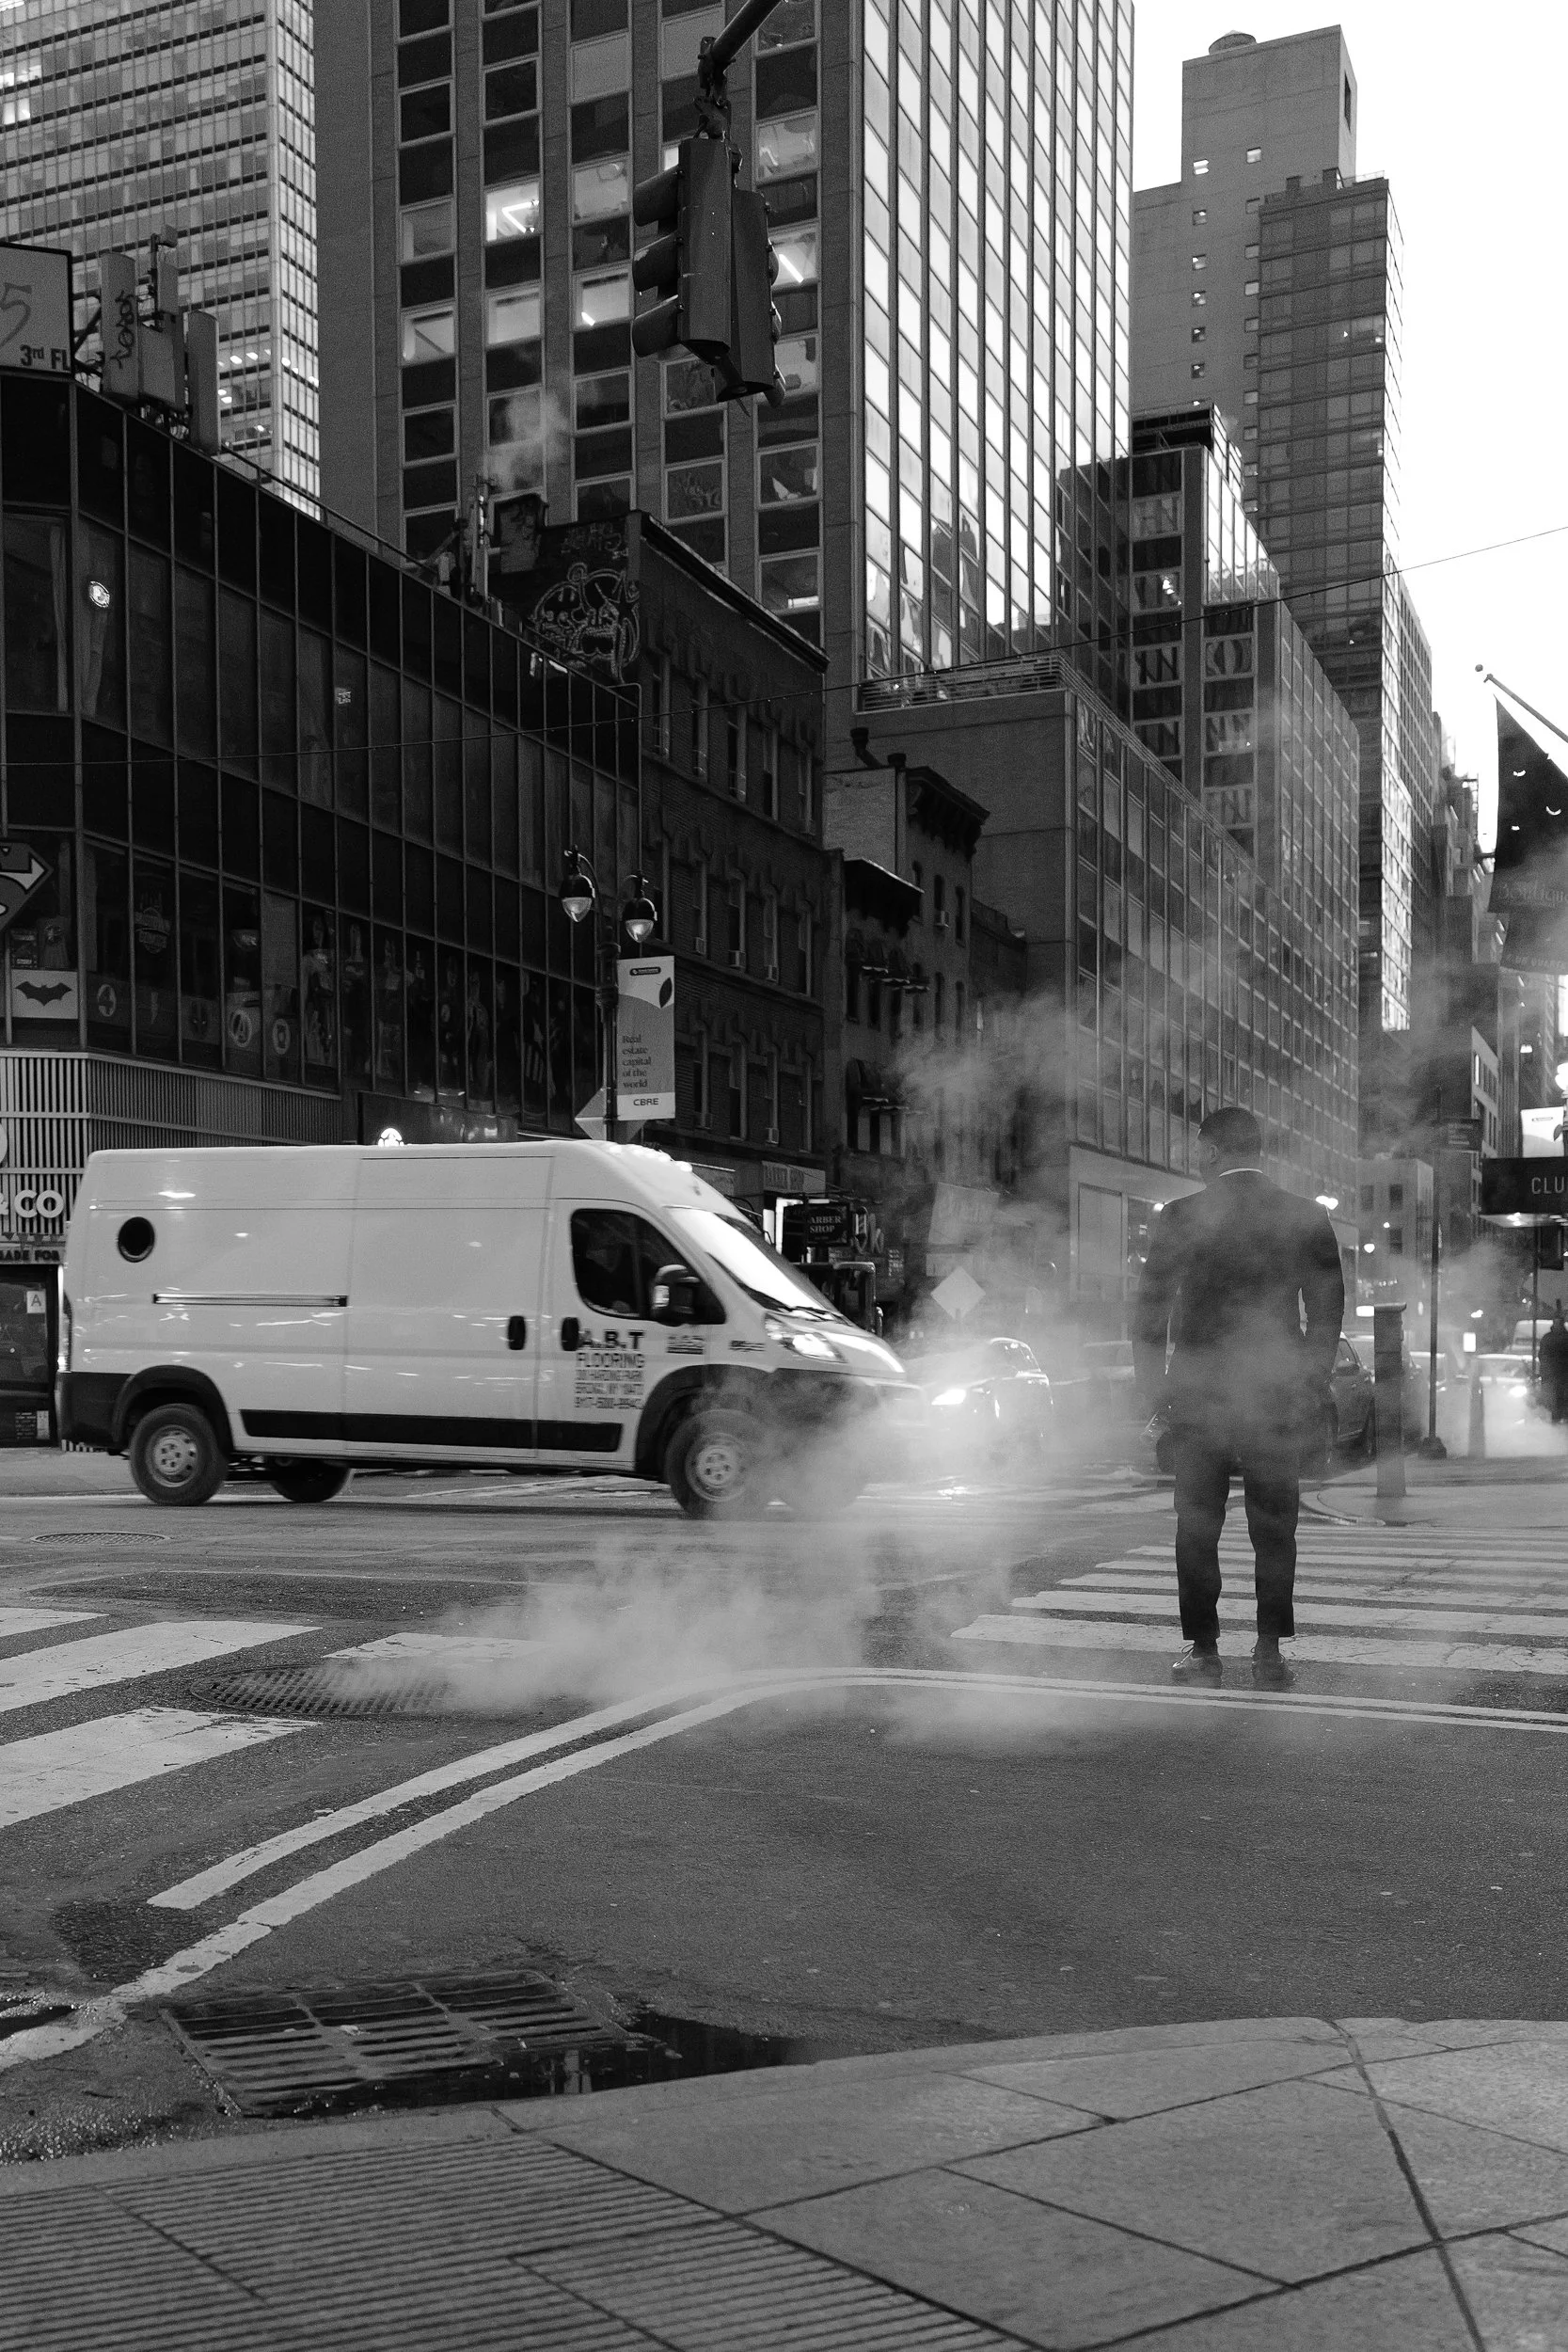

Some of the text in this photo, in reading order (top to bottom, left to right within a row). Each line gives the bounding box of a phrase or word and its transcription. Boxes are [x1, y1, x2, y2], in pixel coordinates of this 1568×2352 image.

[20, 344, 71, 371] 3rd FL
[623, 1034, 641, 1044] Real
[623, 1057, 651, 1067] capital
[623, 1068, 646, 1077] of the
[623, 1078, 648, 1089] world
[633, 1098, 659, 1106] CBRE
[807, 1216, 842, 1225] ARBER
[810, 1225, 835, 1233] SHOP
[31, 1294, 41, 1307] A
[576, 1352, 644, 1368] FLOORING
